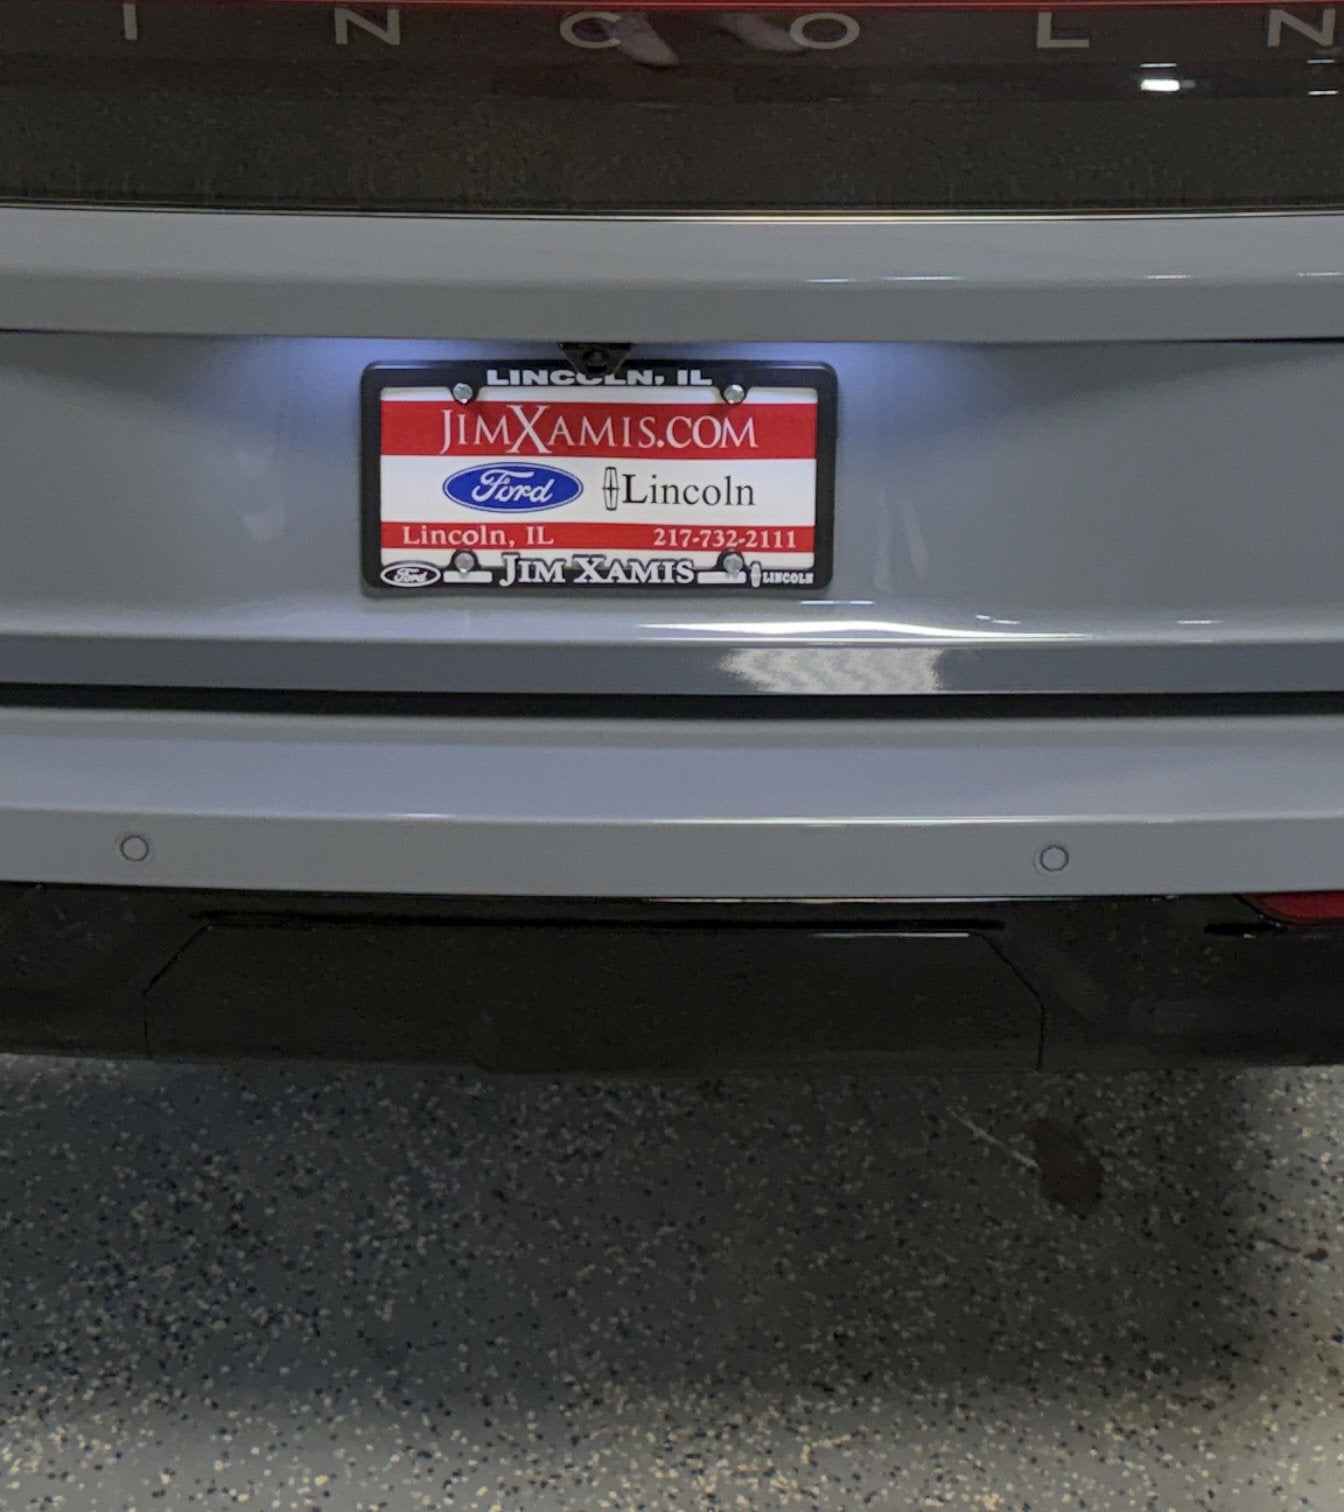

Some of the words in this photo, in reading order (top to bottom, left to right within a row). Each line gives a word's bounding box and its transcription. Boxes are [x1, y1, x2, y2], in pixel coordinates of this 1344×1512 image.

[677, 369, 713, 386] IL
[439, 403, 759, 455] JIMXAMIS.COM
[471, 468, 555, 503] Ford
[622, 473, 757, 506] Lincoln
[402, 524, 516, 548] Lincoln,
[526, 525, 555, 546] IL
[653, 527, 797, 549] 217-732-2111
[498, 553, 567, 587] JIM
[572, 556, 695, 585] XAMIS
[762, 571, 814, 585] LINCOLN
